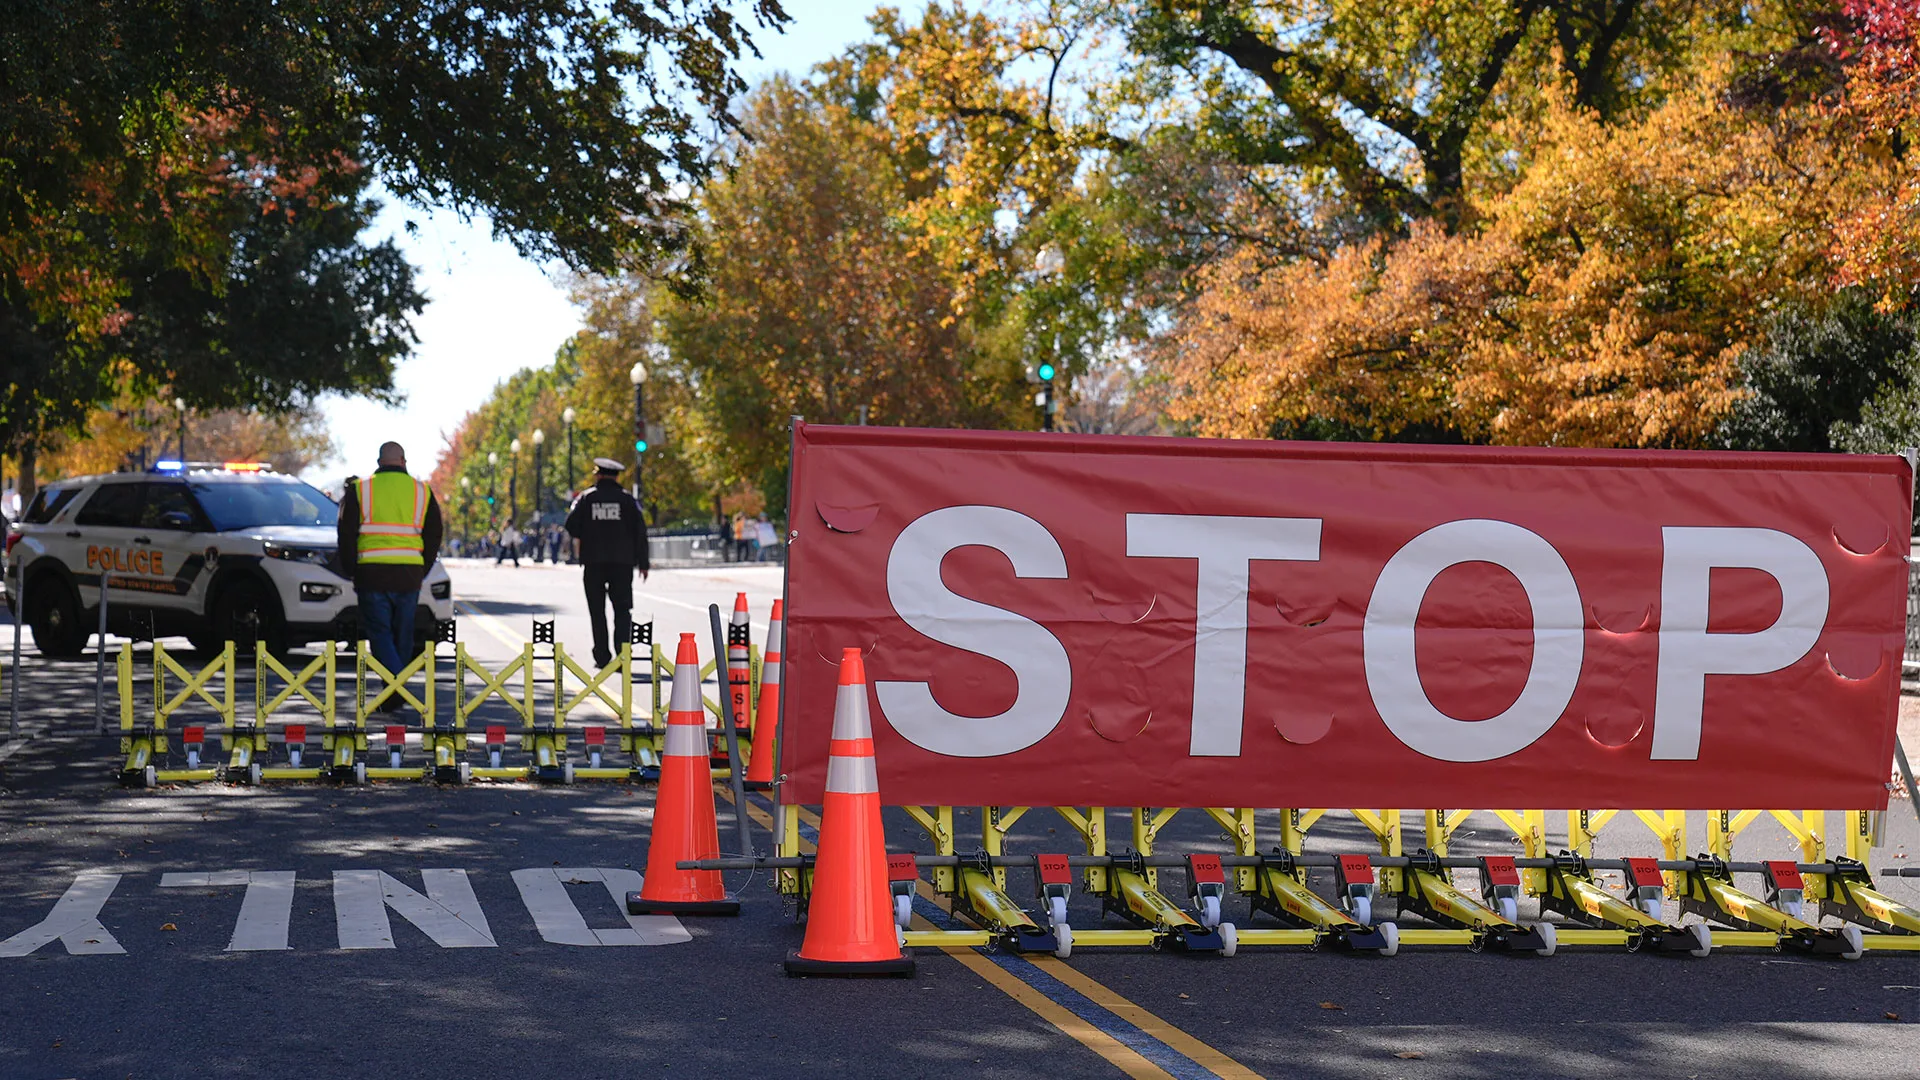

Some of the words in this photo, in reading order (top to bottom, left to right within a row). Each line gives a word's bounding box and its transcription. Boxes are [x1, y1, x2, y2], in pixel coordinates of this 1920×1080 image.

[592, 508, 621, 520] POLICE
[87, 545, 164, 575] POLICE
[874, 505, 1831, 763] STOP
[889, 861, 912, 869] STOP
[1043, 863, 1067, 871] STOP
[1196, 863, 1218, 871] STOP
[1346, 863, 1368, 871] STOP
[1492, 864, 1514, 873] STOP
[1636, 865, 1658, 874] STOP
[1775, 868, 1797, 877] STOP
[0, 868, 692, 955] ONLY
